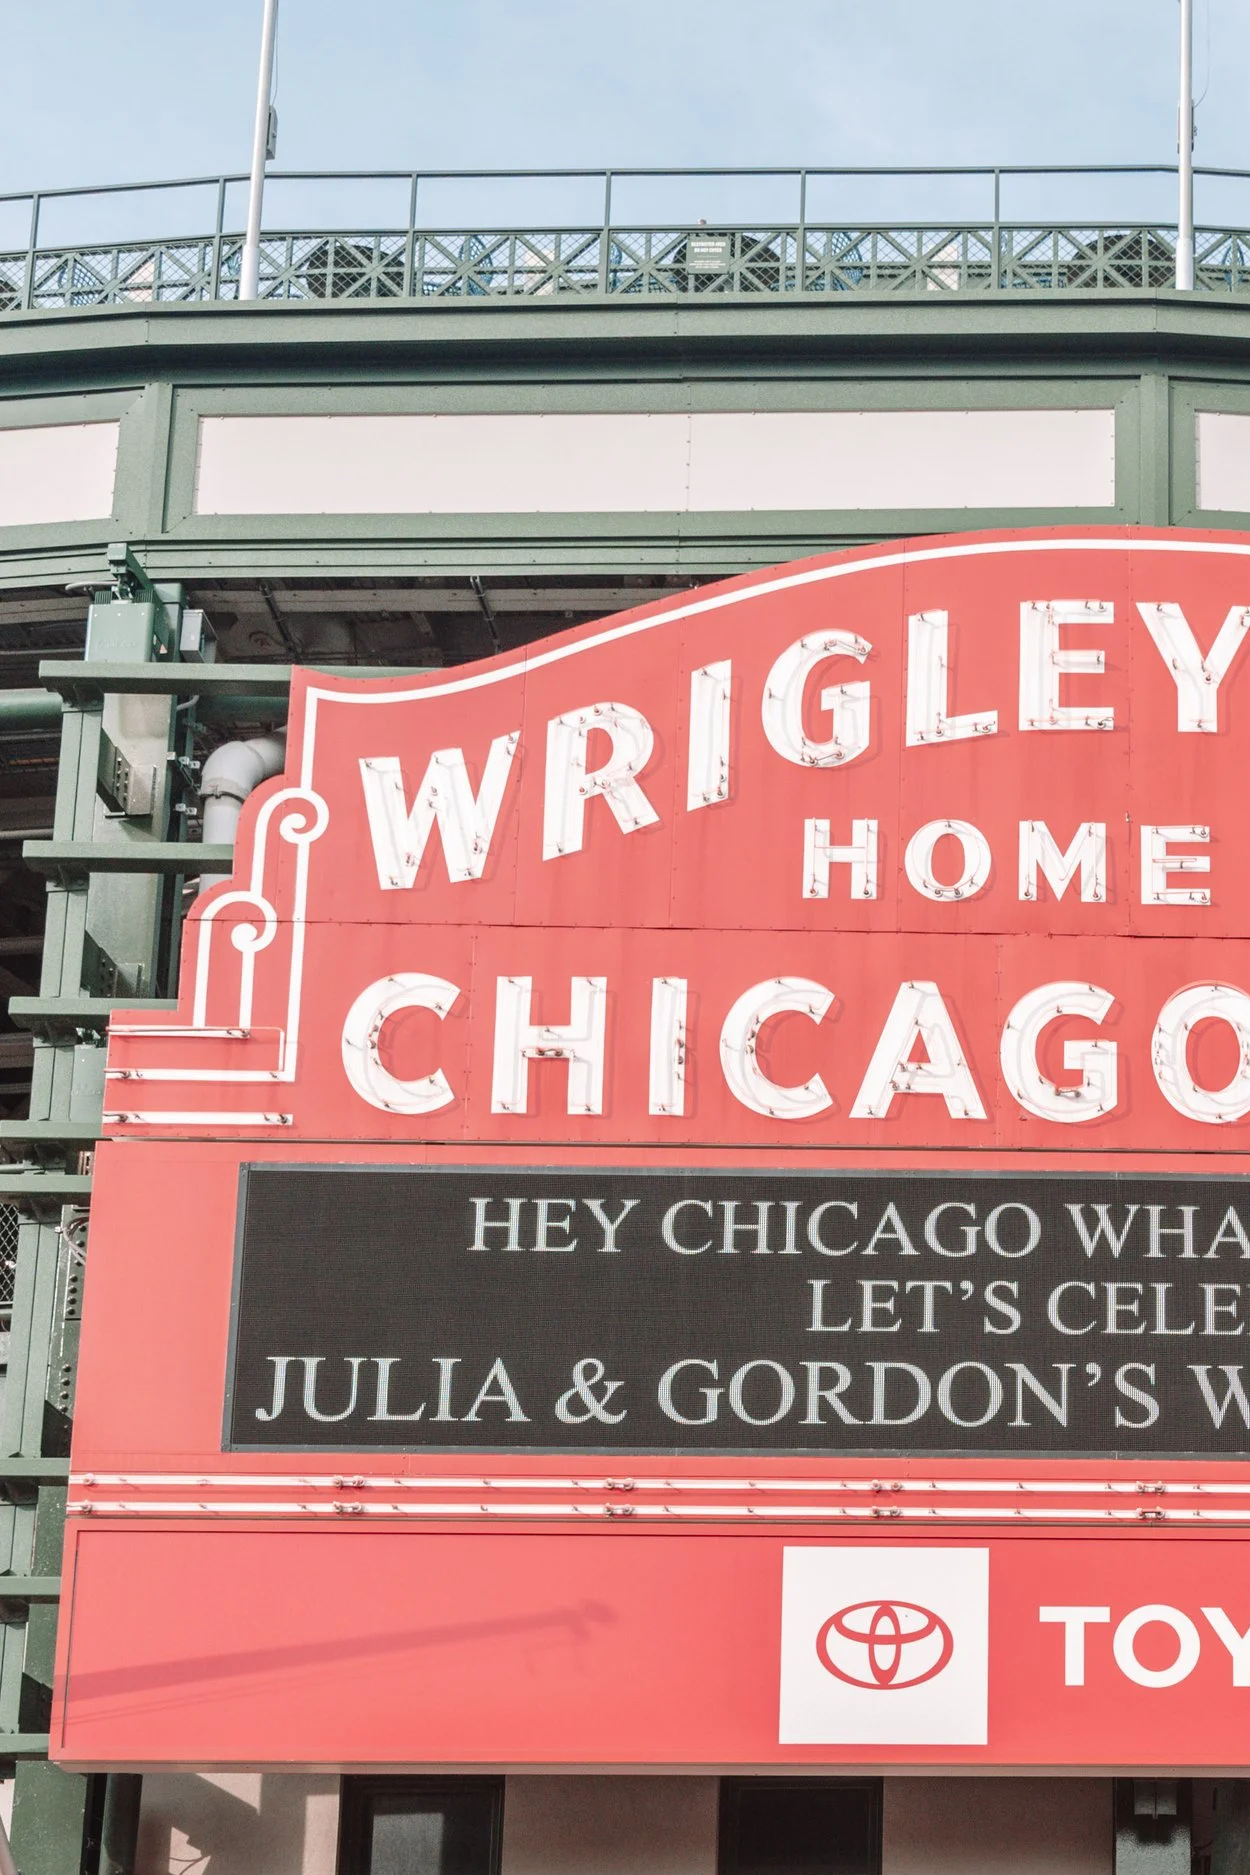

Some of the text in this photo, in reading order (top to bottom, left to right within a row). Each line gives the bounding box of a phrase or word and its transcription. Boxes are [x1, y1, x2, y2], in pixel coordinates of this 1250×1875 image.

[802, 817, 1211, 906] HOME
[468, 1197, 641, 1253] HEY
[661, 1199, 1042, 1258] CHICAGO
[805, 1279, 1022, 1335] LET’S
[255, 1356, 533, 1423] JULIA
[554, 1357, 628, 1425] &
[657, 1358, 1160, 1429] GORDON’S
